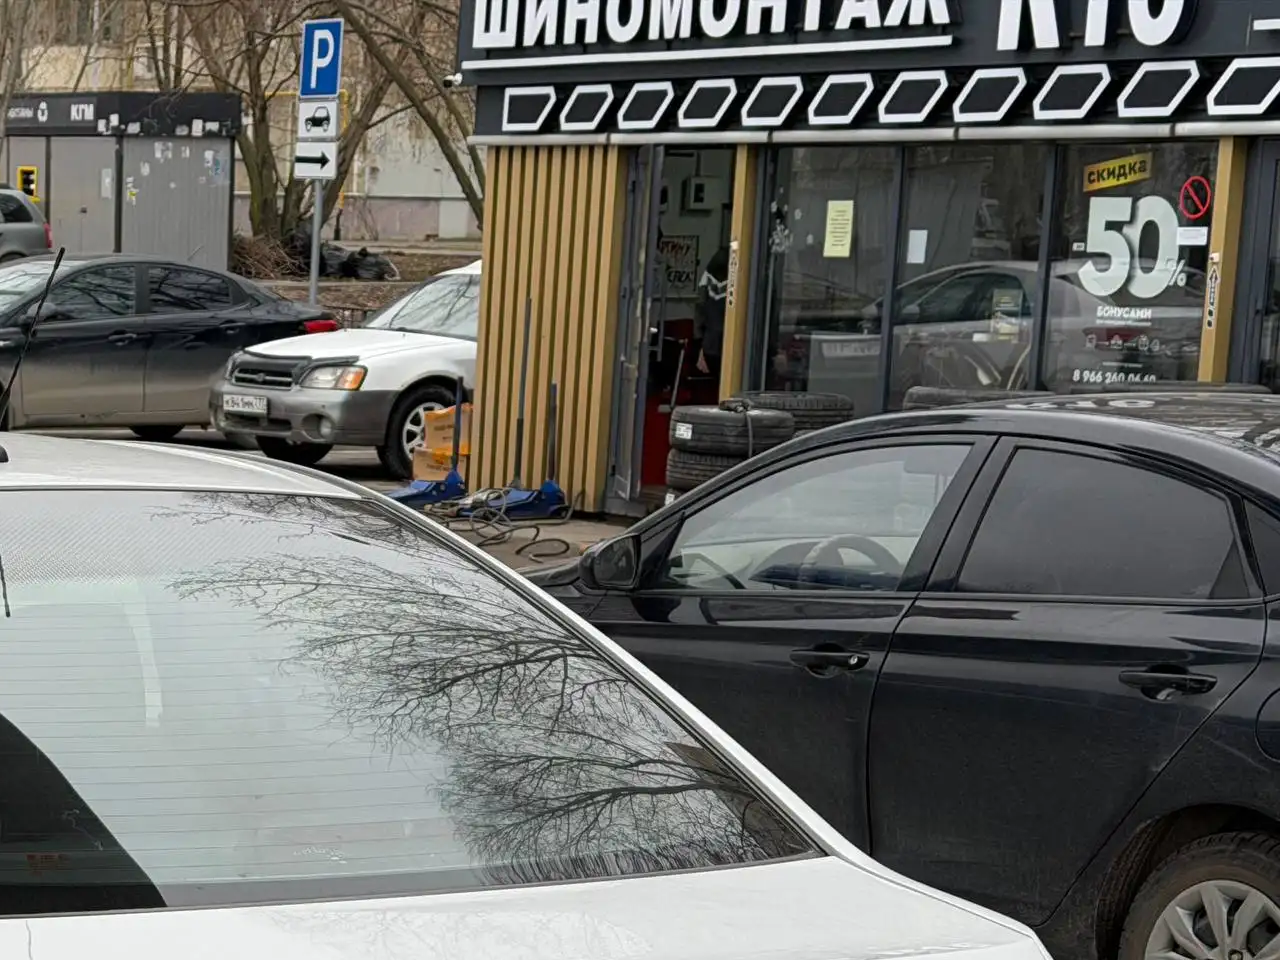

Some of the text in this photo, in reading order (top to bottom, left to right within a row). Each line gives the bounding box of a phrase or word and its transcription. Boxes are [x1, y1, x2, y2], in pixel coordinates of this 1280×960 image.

[310, 29, 335, 89] P
[70, 104, 95, 121] КГМ
[1096, 306, 1153, 320] БОНУСАМИ
[1072, 369, 1081, 382] 8
[1083, 370, 1103, 383] 966
